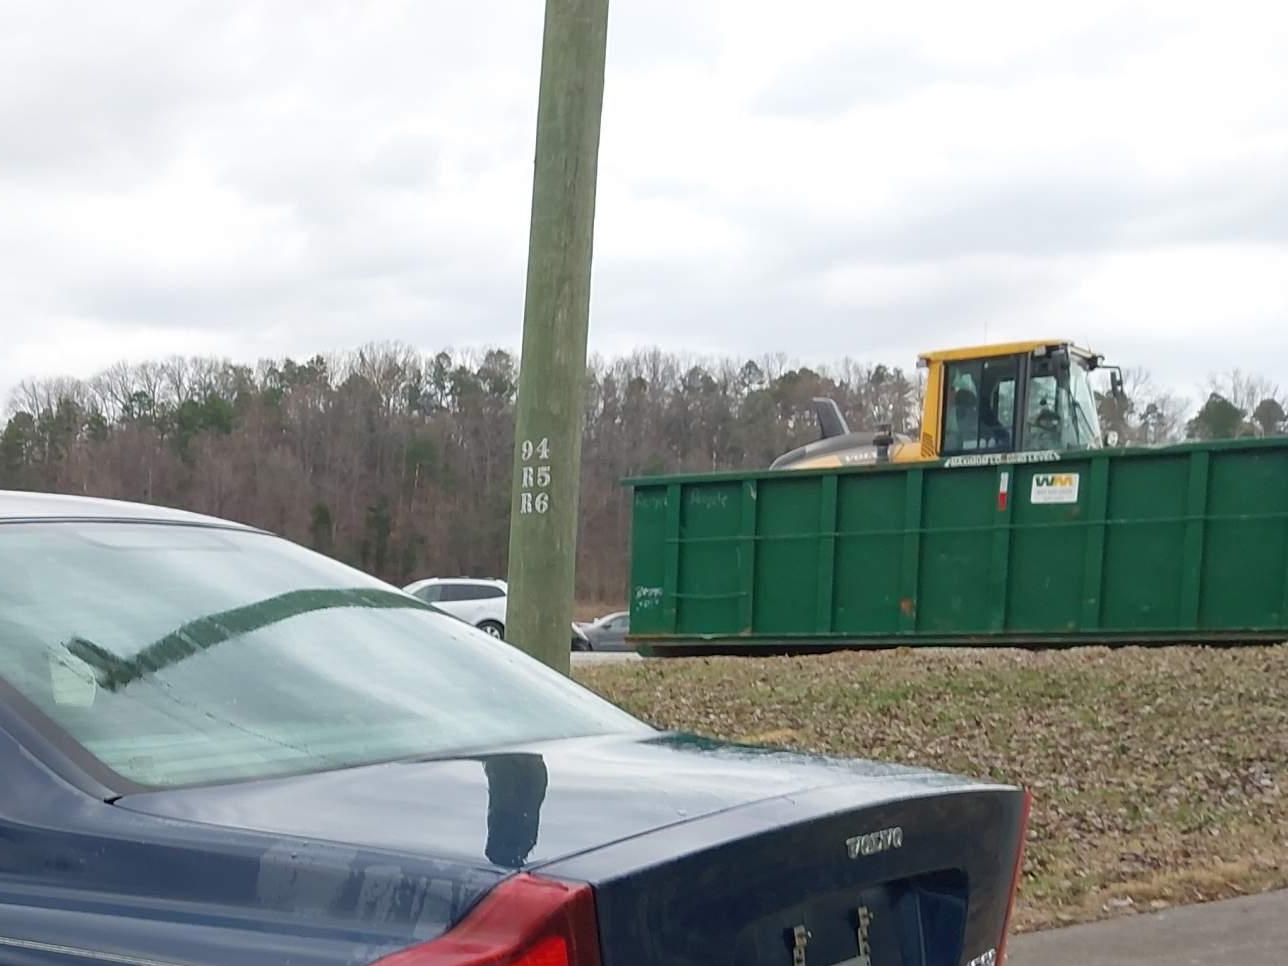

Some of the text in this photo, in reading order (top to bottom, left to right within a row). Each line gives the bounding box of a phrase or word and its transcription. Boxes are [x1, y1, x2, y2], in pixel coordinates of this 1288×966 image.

[521, 438, 550, 461] 94
[522, 465, 551, 488] R5
[1035, 476, 1074, 487] WM
[520, 492, 549, 514] R6
[846, 827, 904, 859] VOLVO
